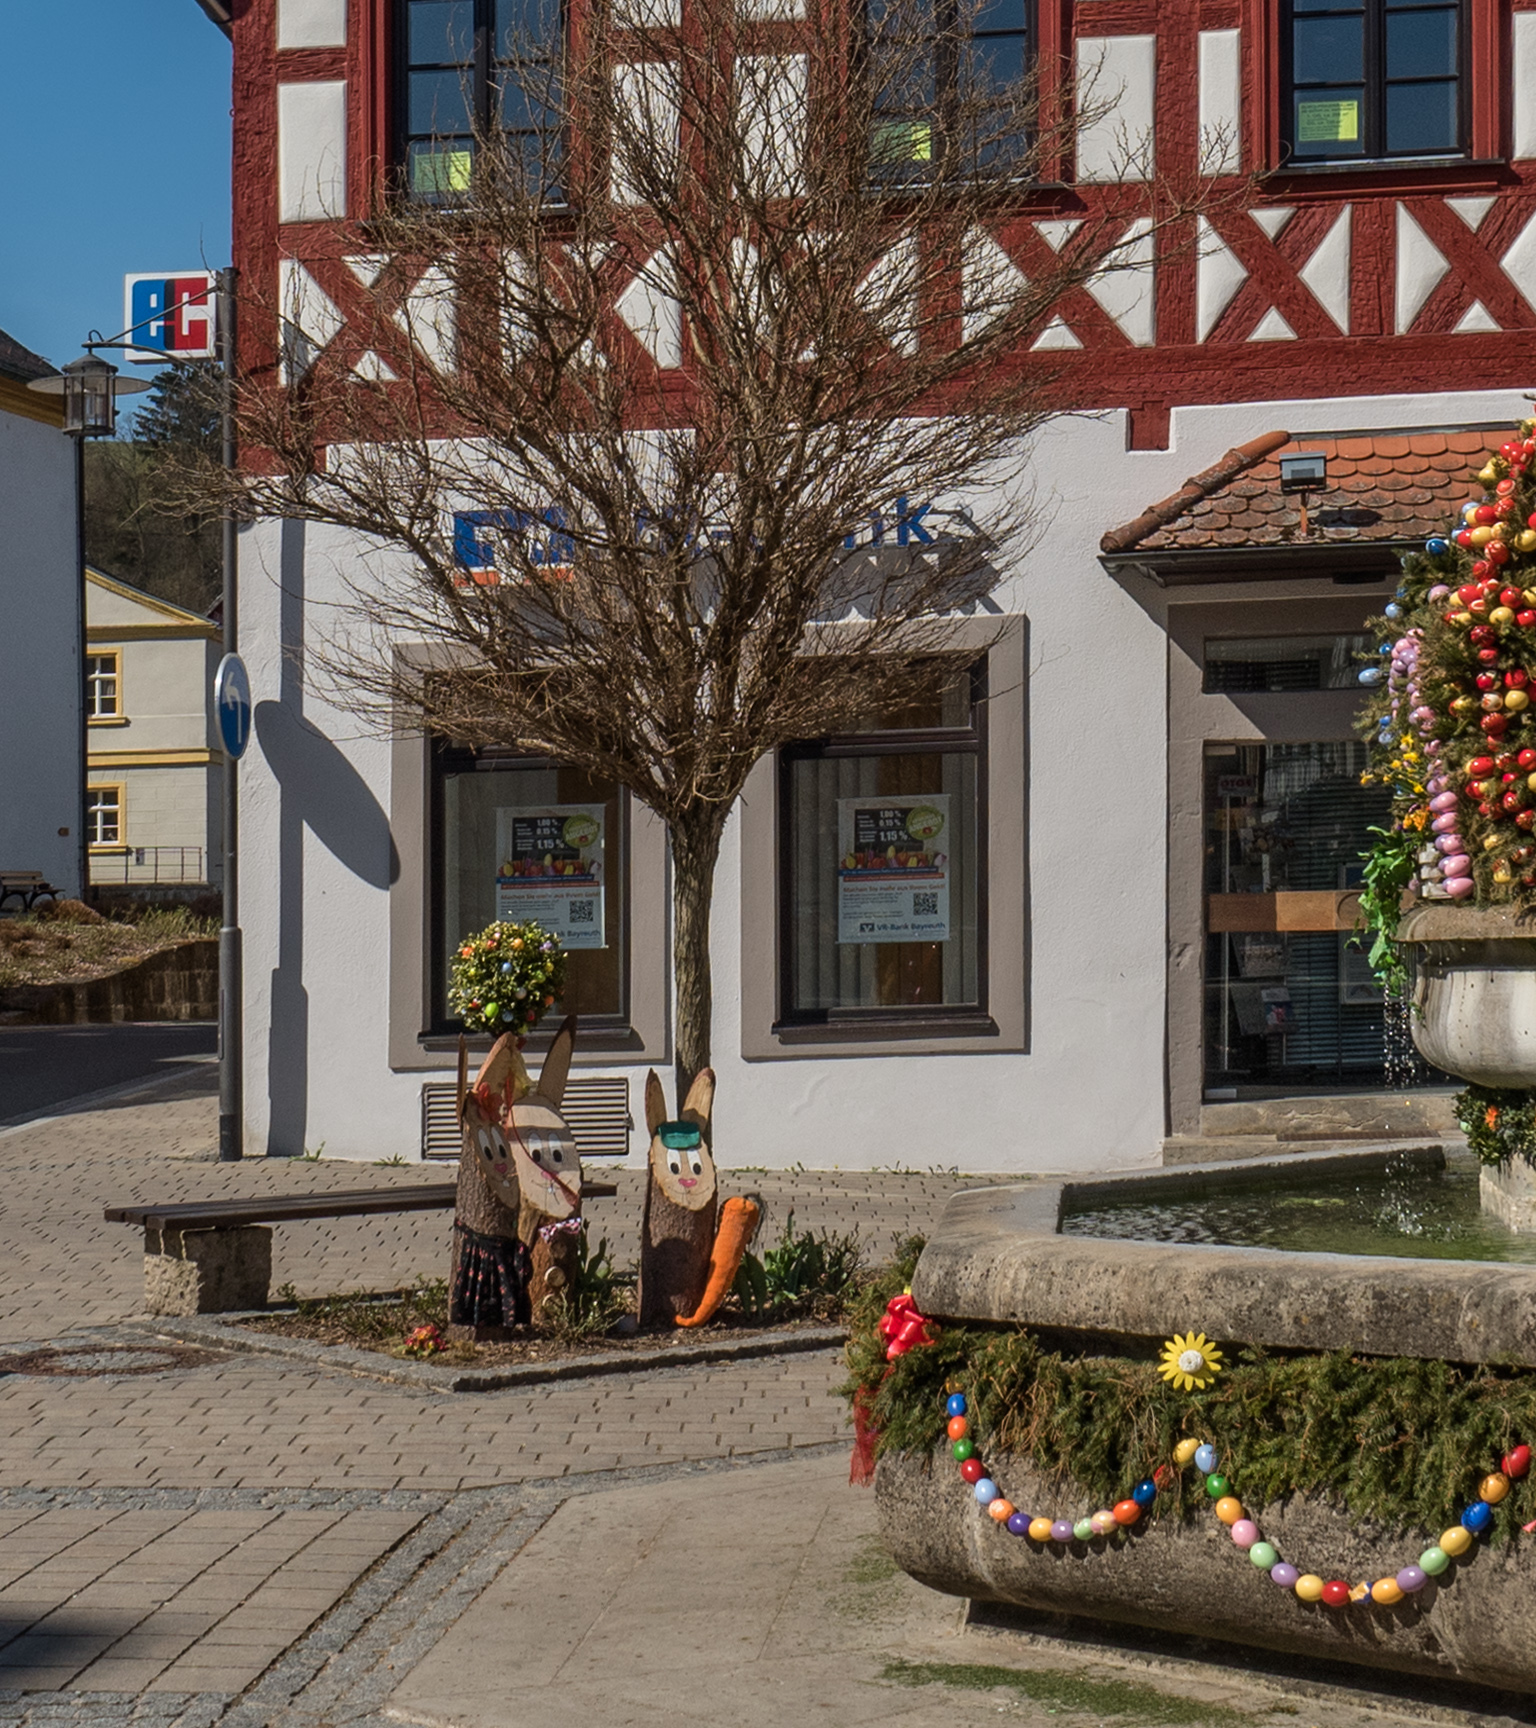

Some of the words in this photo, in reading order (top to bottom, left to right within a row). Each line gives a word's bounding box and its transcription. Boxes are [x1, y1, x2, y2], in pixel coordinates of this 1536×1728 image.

[876, 922, 909, 931] VR-Bank
[911, 921, 946, 932] Bayreuth
[567, 929, 600, 939] Bayreuth
